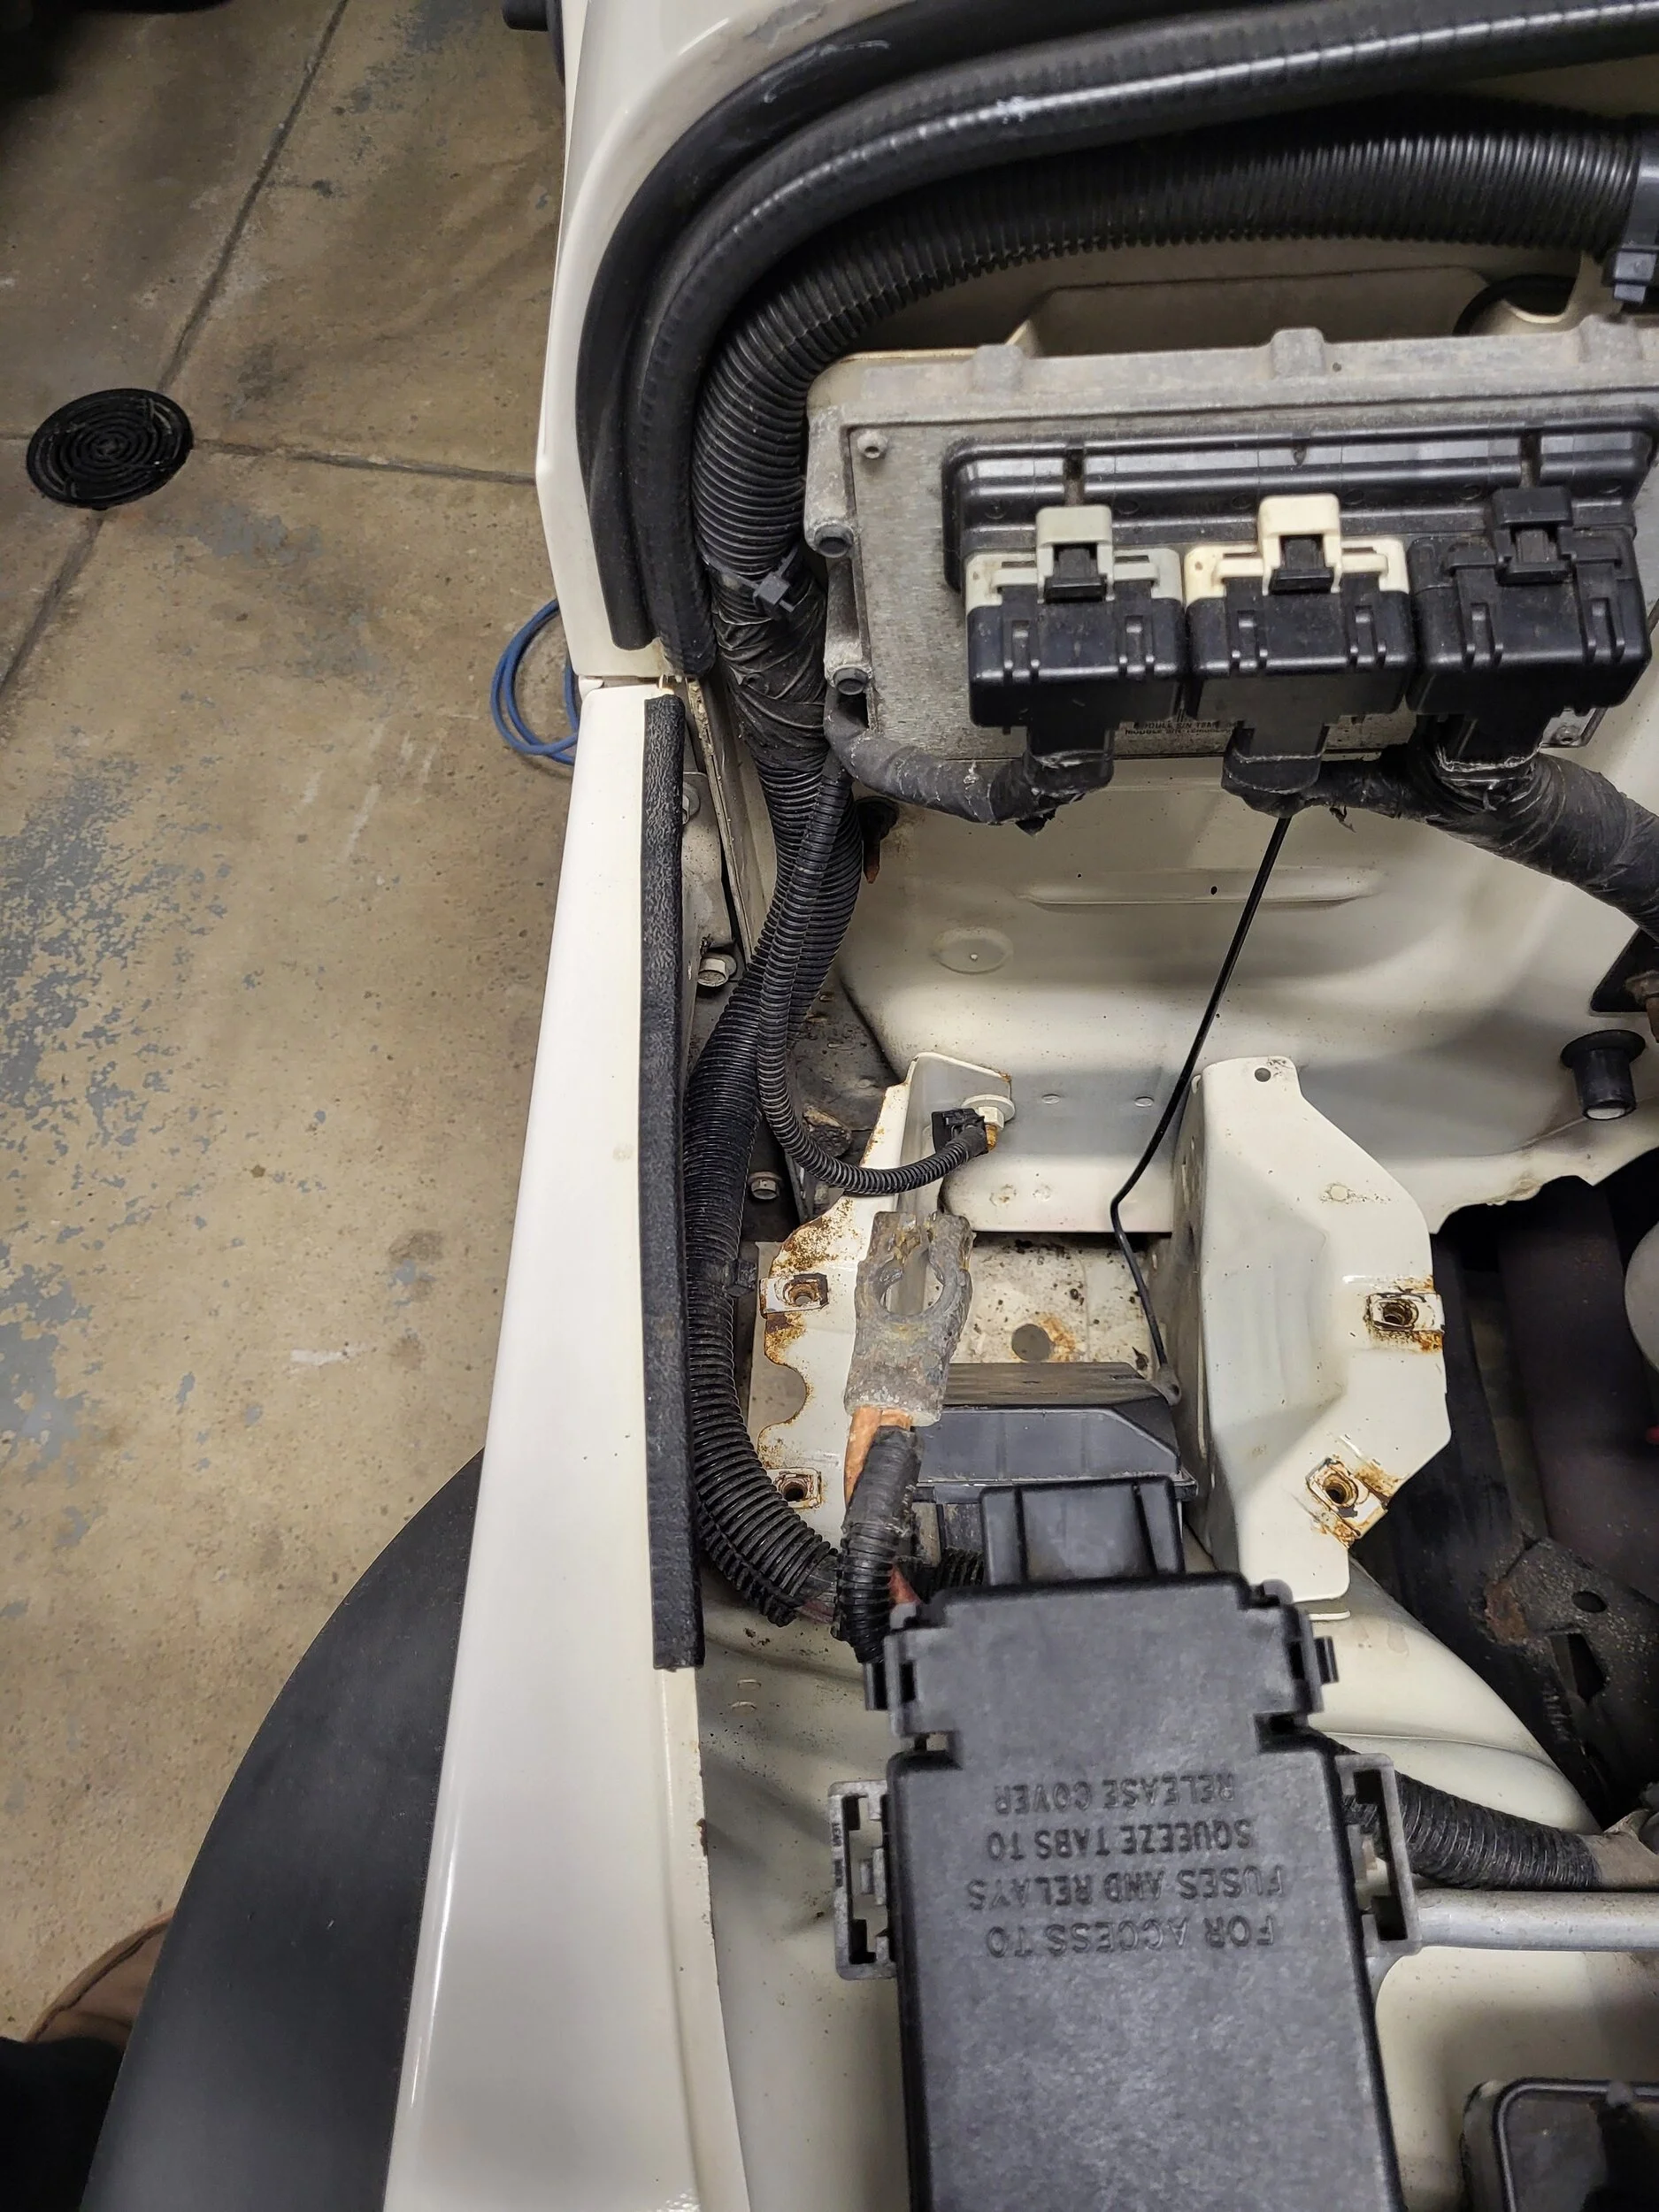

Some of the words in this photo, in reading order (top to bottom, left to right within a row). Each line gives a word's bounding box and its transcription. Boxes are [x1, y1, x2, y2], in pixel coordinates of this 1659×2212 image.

[995, 1780, 1093, 1814] COVER
[1102, 1771, 1236, 1809] RELEASE
[987, 1831, 1025, 1860] TO
[1033, 1825, 1110, 1860] TABS
[1119, 1818, 1253, 1855] SQUEEZE
[967, 1873, 1093, 1910] RELAYS
[1104, 1870, 1166, 1903] AND
[1177, 1864, 1284, 1900] FUSES
[986, 1925, 1033, 1958] TO
[1045, 1916, 1190, 1956] ACCESS
[1203, 1914, 1275, 1947] FOR
